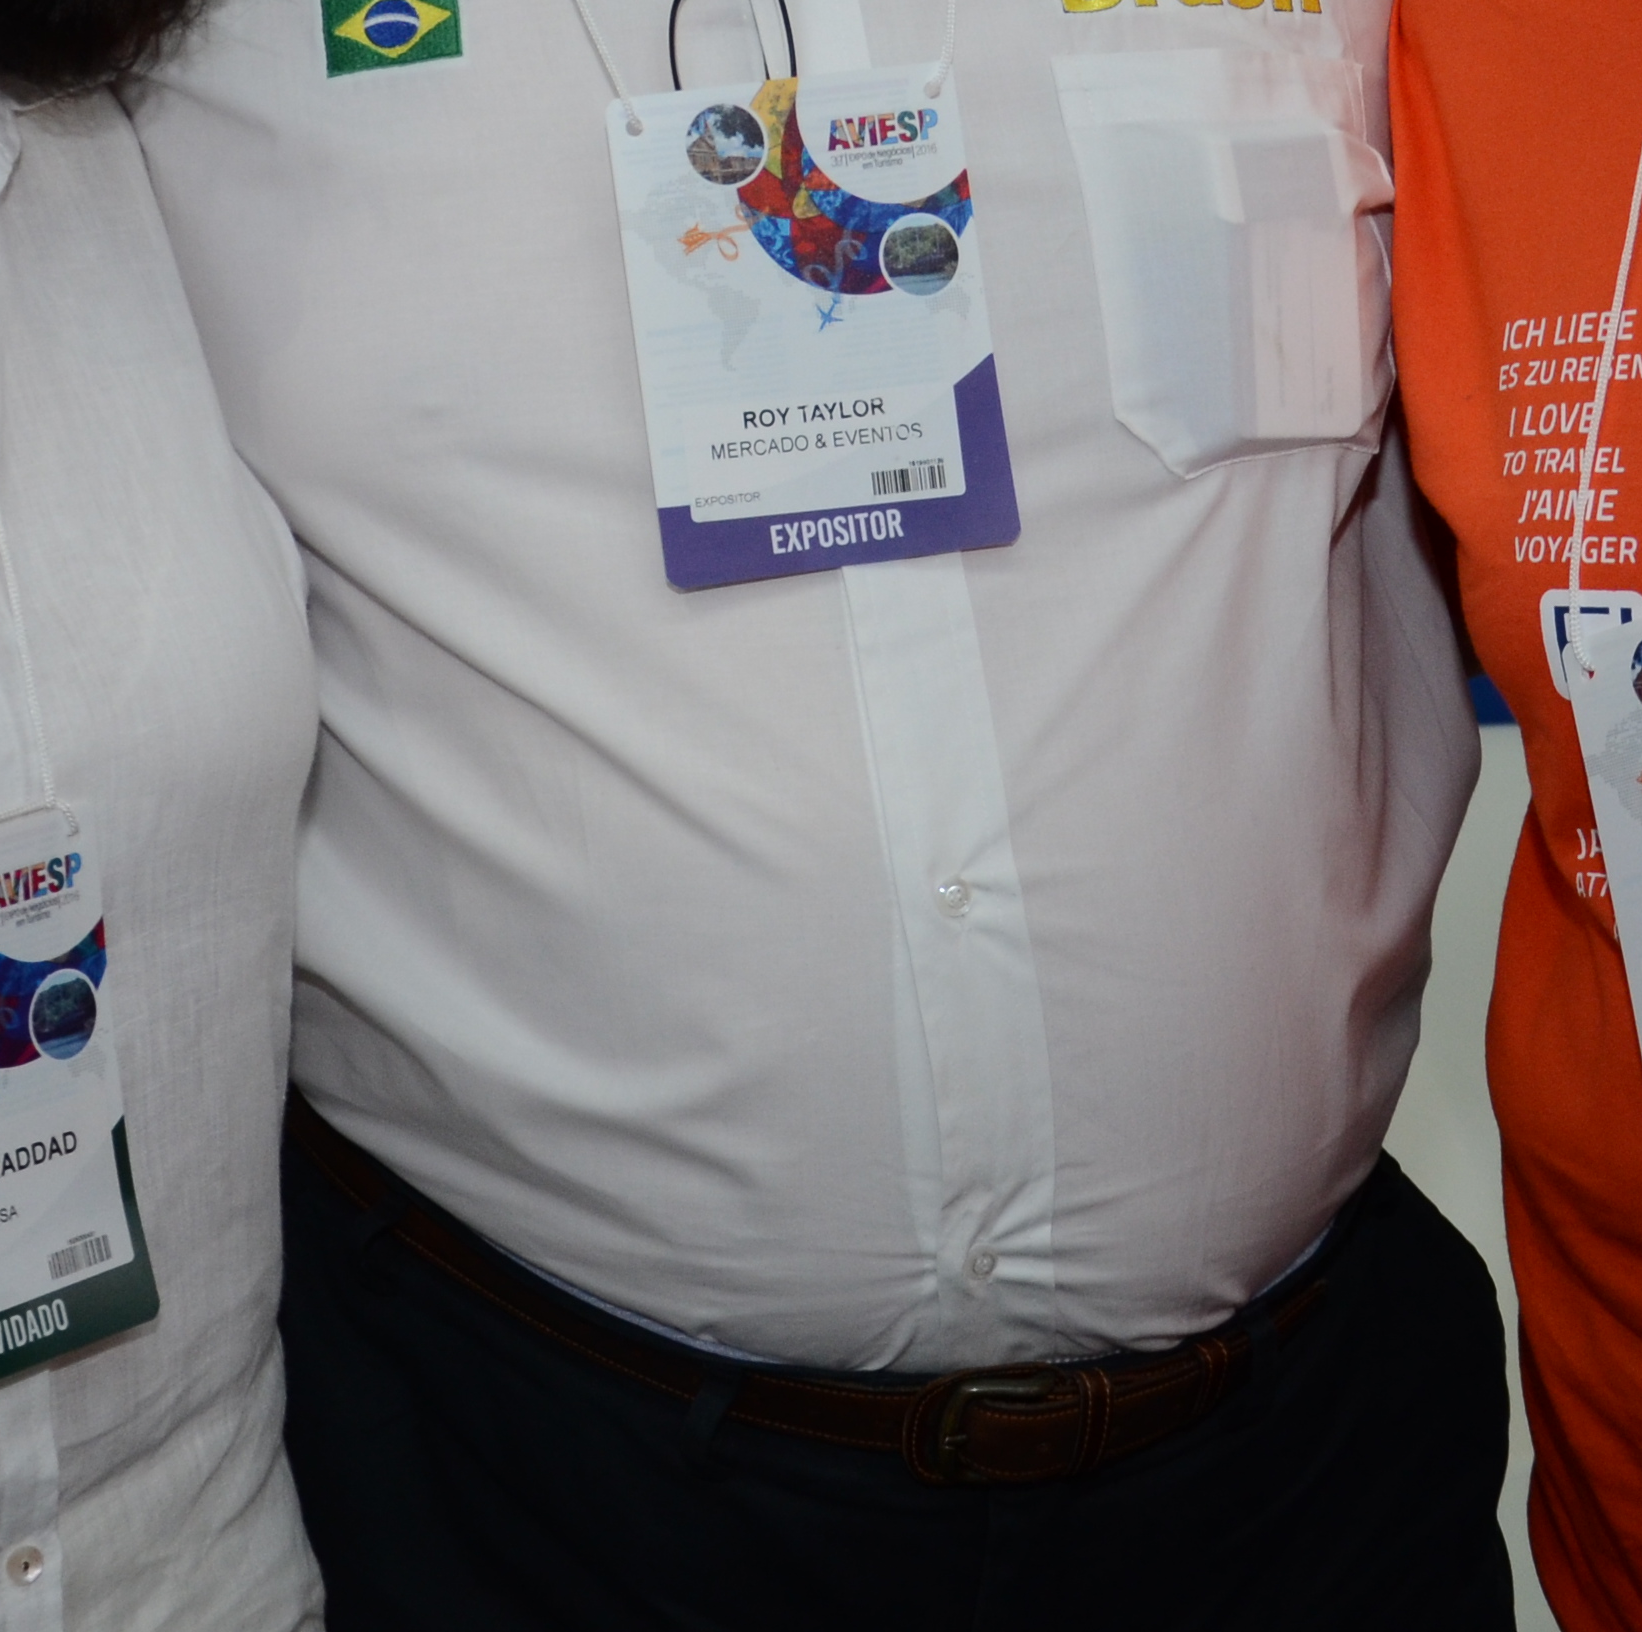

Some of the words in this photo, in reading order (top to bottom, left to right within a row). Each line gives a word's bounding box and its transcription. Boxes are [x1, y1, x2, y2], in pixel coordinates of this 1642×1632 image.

[827, 108, 939, 152] AVIESP
[1502, 317, 1547, 352] ICH
[1499, 362, 1521, 392] ES
[1524, 359, 1556, 386] ZU
[742, 407, 790, 430] ROY
[797, 397, 886, 424] TAYLOR
[1509, 407, 1517, 438] I
[1522, 402, 1597, 436] LOVE
[710, 434, 810, 461] MERCADO
[814, 433, 828, 450] &
[832, 422, 924, 448] EVENTOS
[1502, 449, 1527, 477] TO
[694, 490, 762, 509] EXPOSITOR
[769, 508, 905, 555] EXPOSITOR
